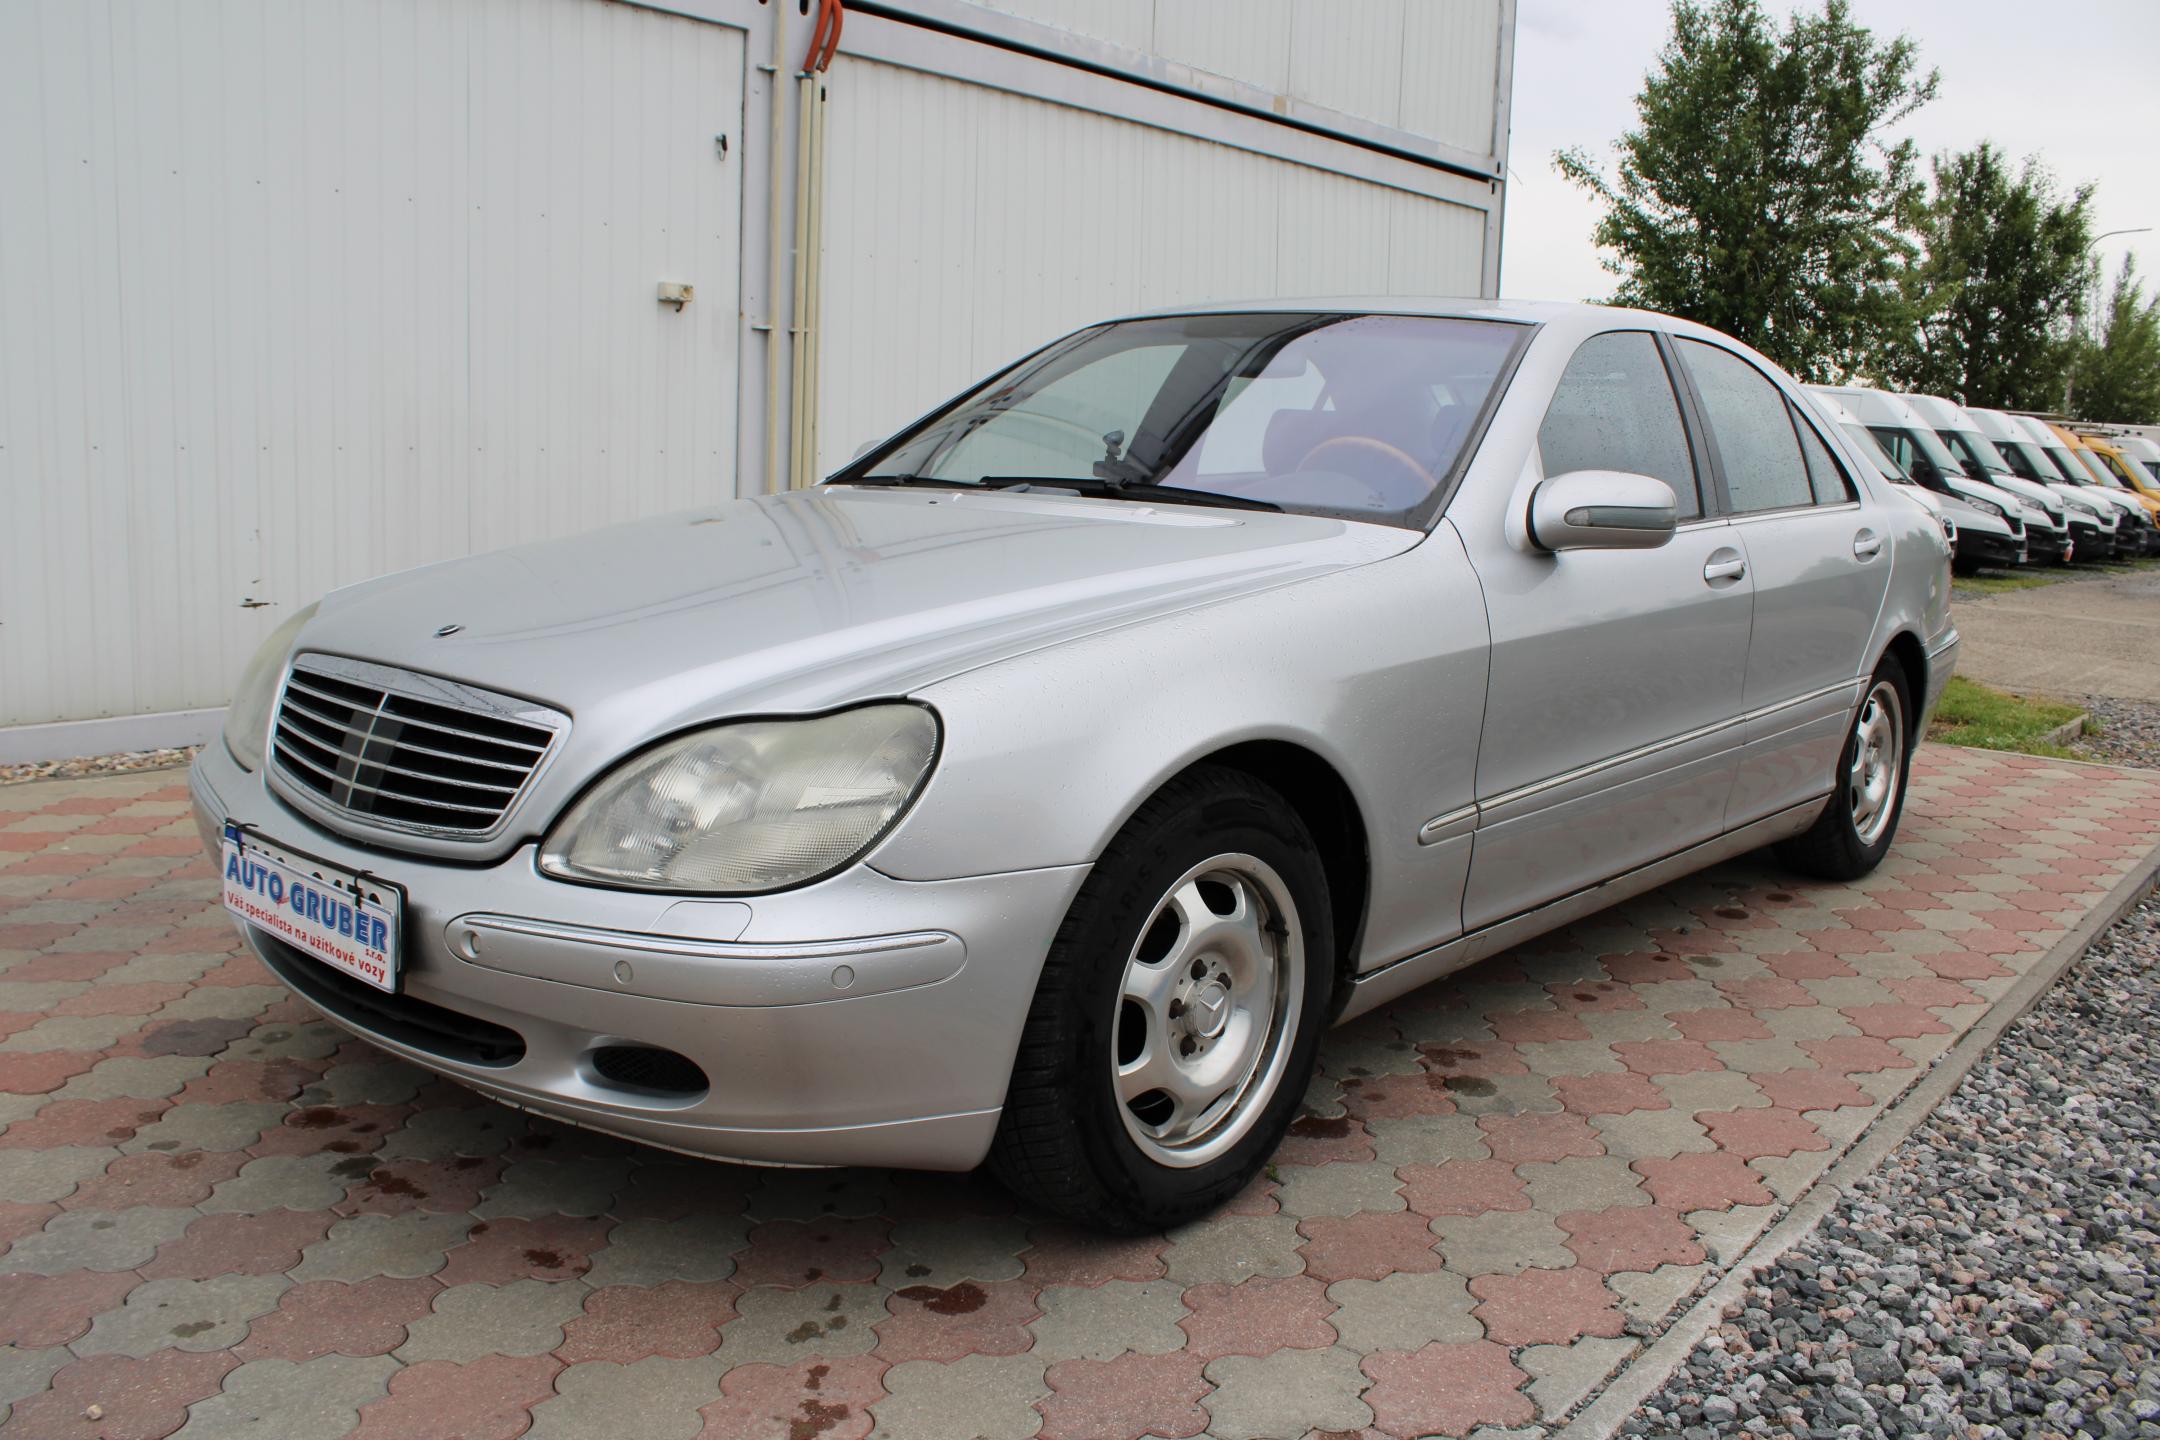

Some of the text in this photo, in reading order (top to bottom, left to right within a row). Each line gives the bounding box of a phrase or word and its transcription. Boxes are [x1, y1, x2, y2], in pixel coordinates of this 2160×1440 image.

[226, 852, 284, 903] AUTO
[290, 882, 388, 953] GRUBER
[246, 903, 292, 935] specialista
[295, 929, 307, 941] na
[310, 935, 355, 965] užitkové
[359, 958, 385, 983] vozy
